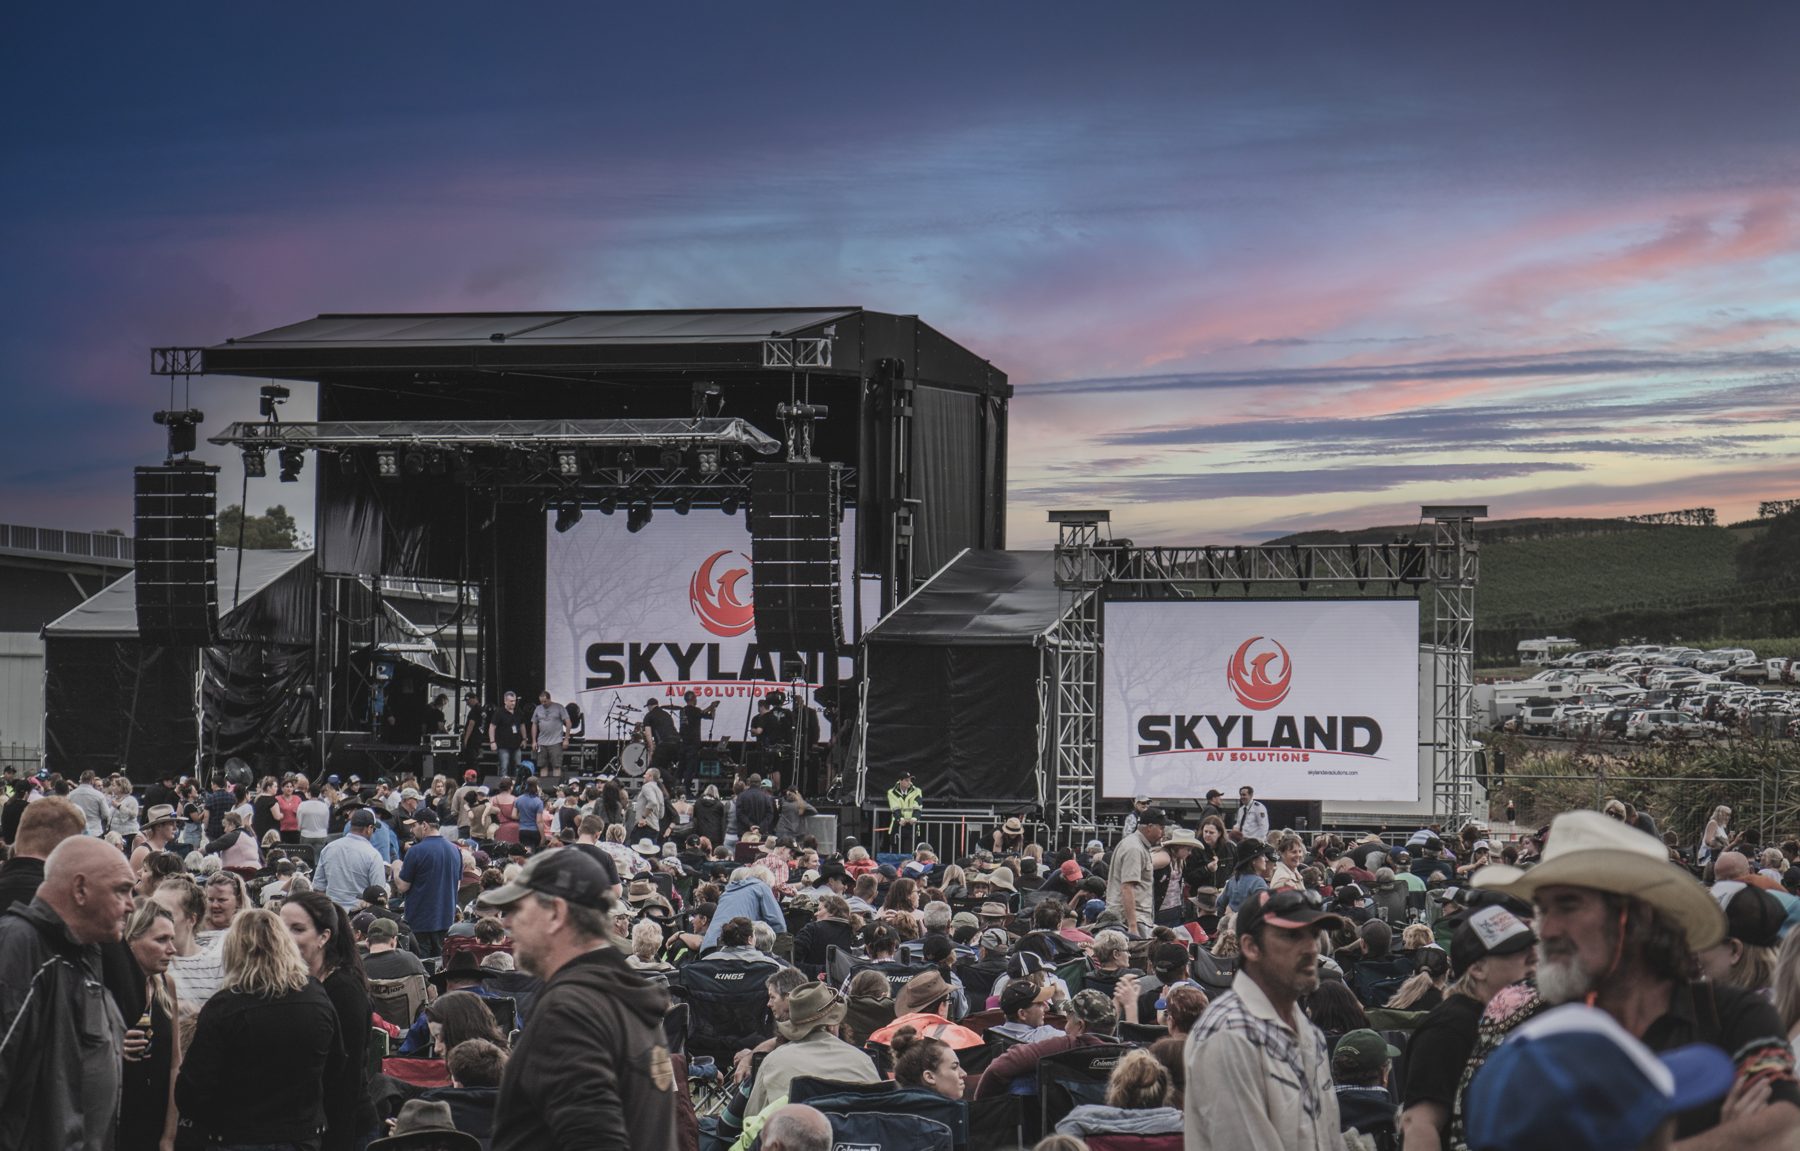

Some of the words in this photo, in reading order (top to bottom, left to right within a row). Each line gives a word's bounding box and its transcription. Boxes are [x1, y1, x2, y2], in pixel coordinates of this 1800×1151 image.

[665, 686, 686, 697] AV
[1137, 714, 1383, 756] SKYLAND
[1206, 752, 1225, 762] AV
[1230, 752, 1311, 762] SOLUTIONS
[714, 972, 746, 980] KINGS
